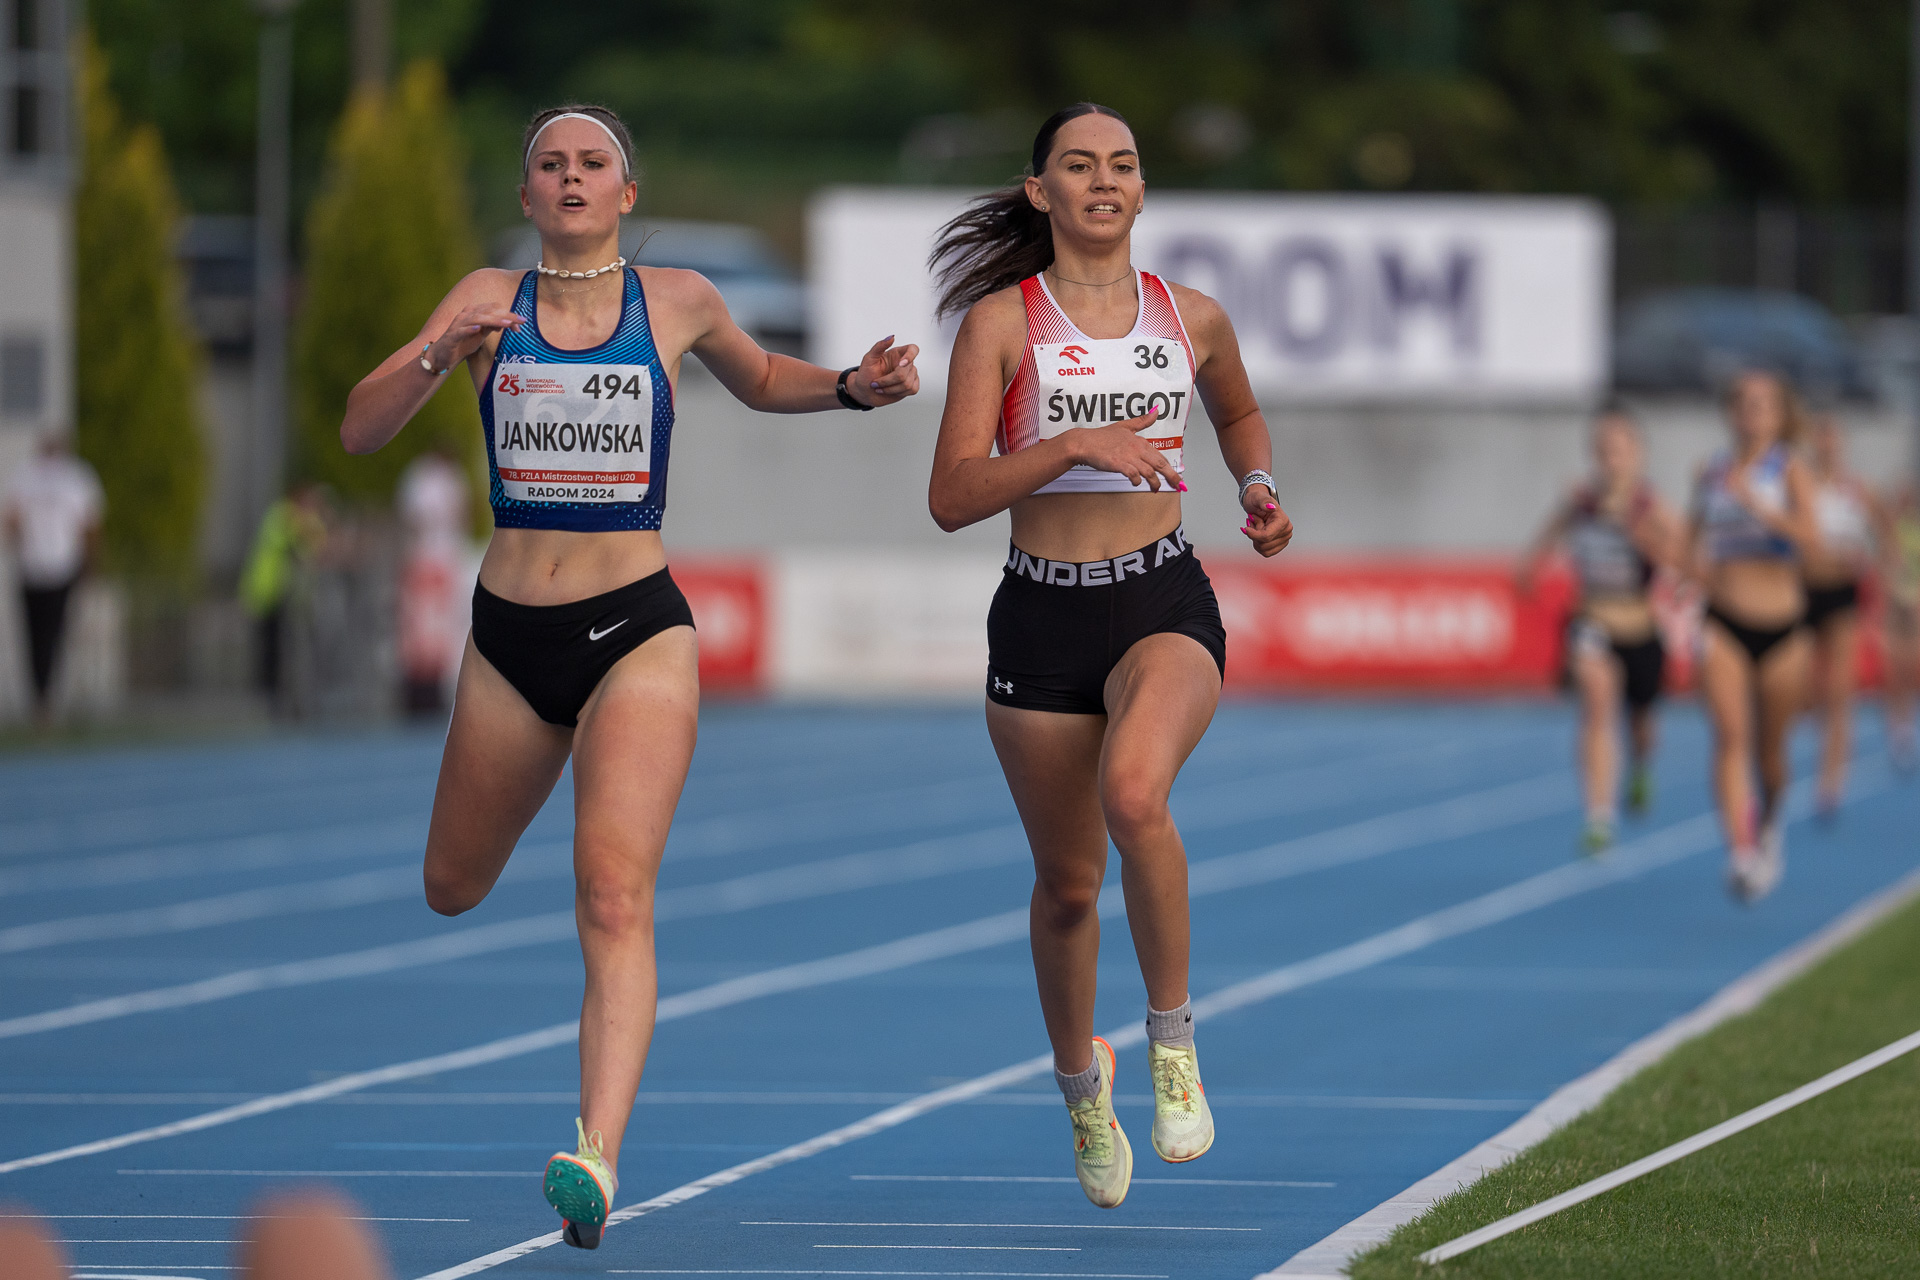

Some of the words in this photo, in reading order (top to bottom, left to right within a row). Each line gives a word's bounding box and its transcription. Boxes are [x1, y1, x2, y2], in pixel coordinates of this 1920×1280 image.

[1133, 344, 1169, 369] 36
[1057, 366, 1095, 376] ORLEN
[582, 373, 641, 400] 494
[1047, 388, 1186, 423] ŚWIEGOT
[501, 420, 644, 454] JANKOWSKA
[508, 471, 519, 479] 78.
[521, 472, 540, 480] PZLA
[542, 473, 593, 481] Mistrzostwa
[595, 474, 619, 482] Polski
[620, 473, 636, 481] U20
[527, 487, 579, 498] RADOM
[581, 488, 615, 499] 2024
[1007, 546, 1148, 587] UNDER
